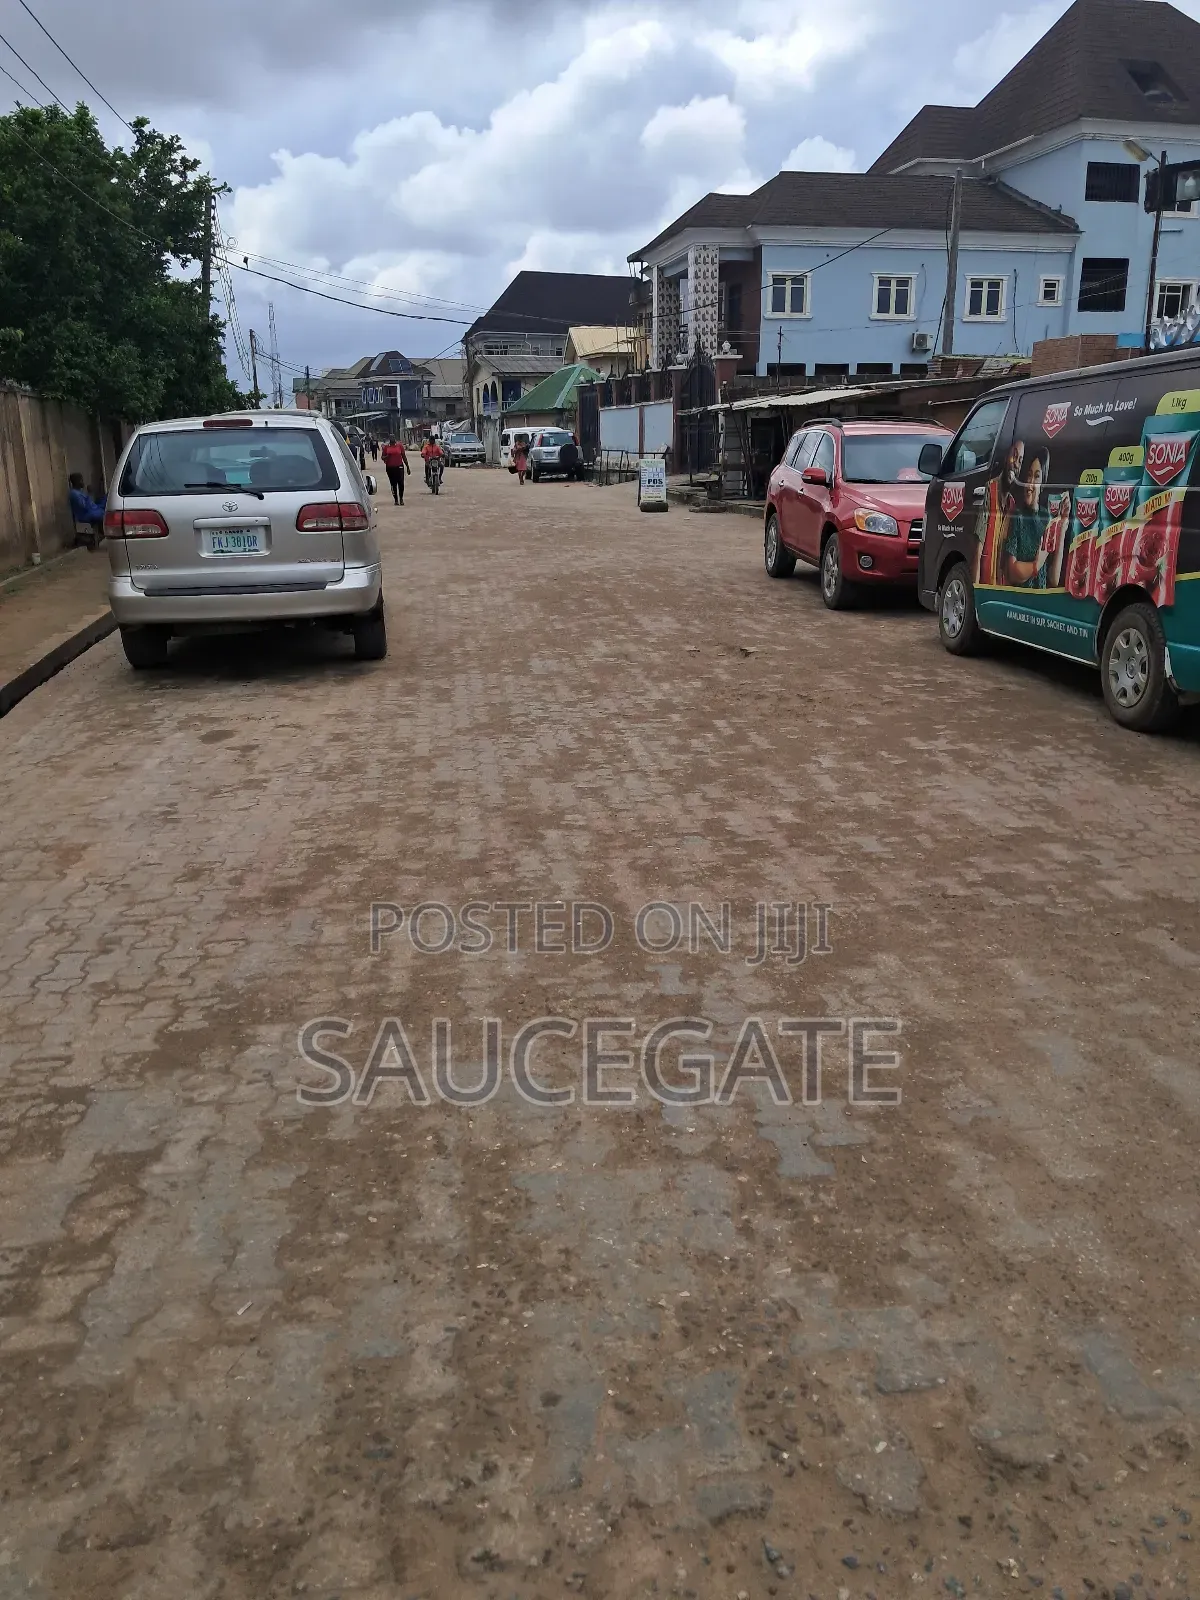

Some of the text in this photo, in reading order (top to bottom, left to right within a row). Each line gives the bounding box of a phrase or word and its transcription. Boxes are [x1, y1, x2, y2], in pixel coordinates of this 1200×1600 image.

[1044, 407, 1068, 423] SONIA
[1074, 398, 1137, 416] So Much to Love!
[1119, 453, 1134, 464] 400g
[1148, 442, 1186, 465] SONIA
[942, 487, 964, 504] SONIA
[1105, 487, 1130, 502] SONIA
[1077, 502, 1097, 515] SONIA
[1006, 610, 1030, 622] AVAILABLE
[1066, 624, 1078, 635] AND
[1079, 628, 1089, 638] TIN
